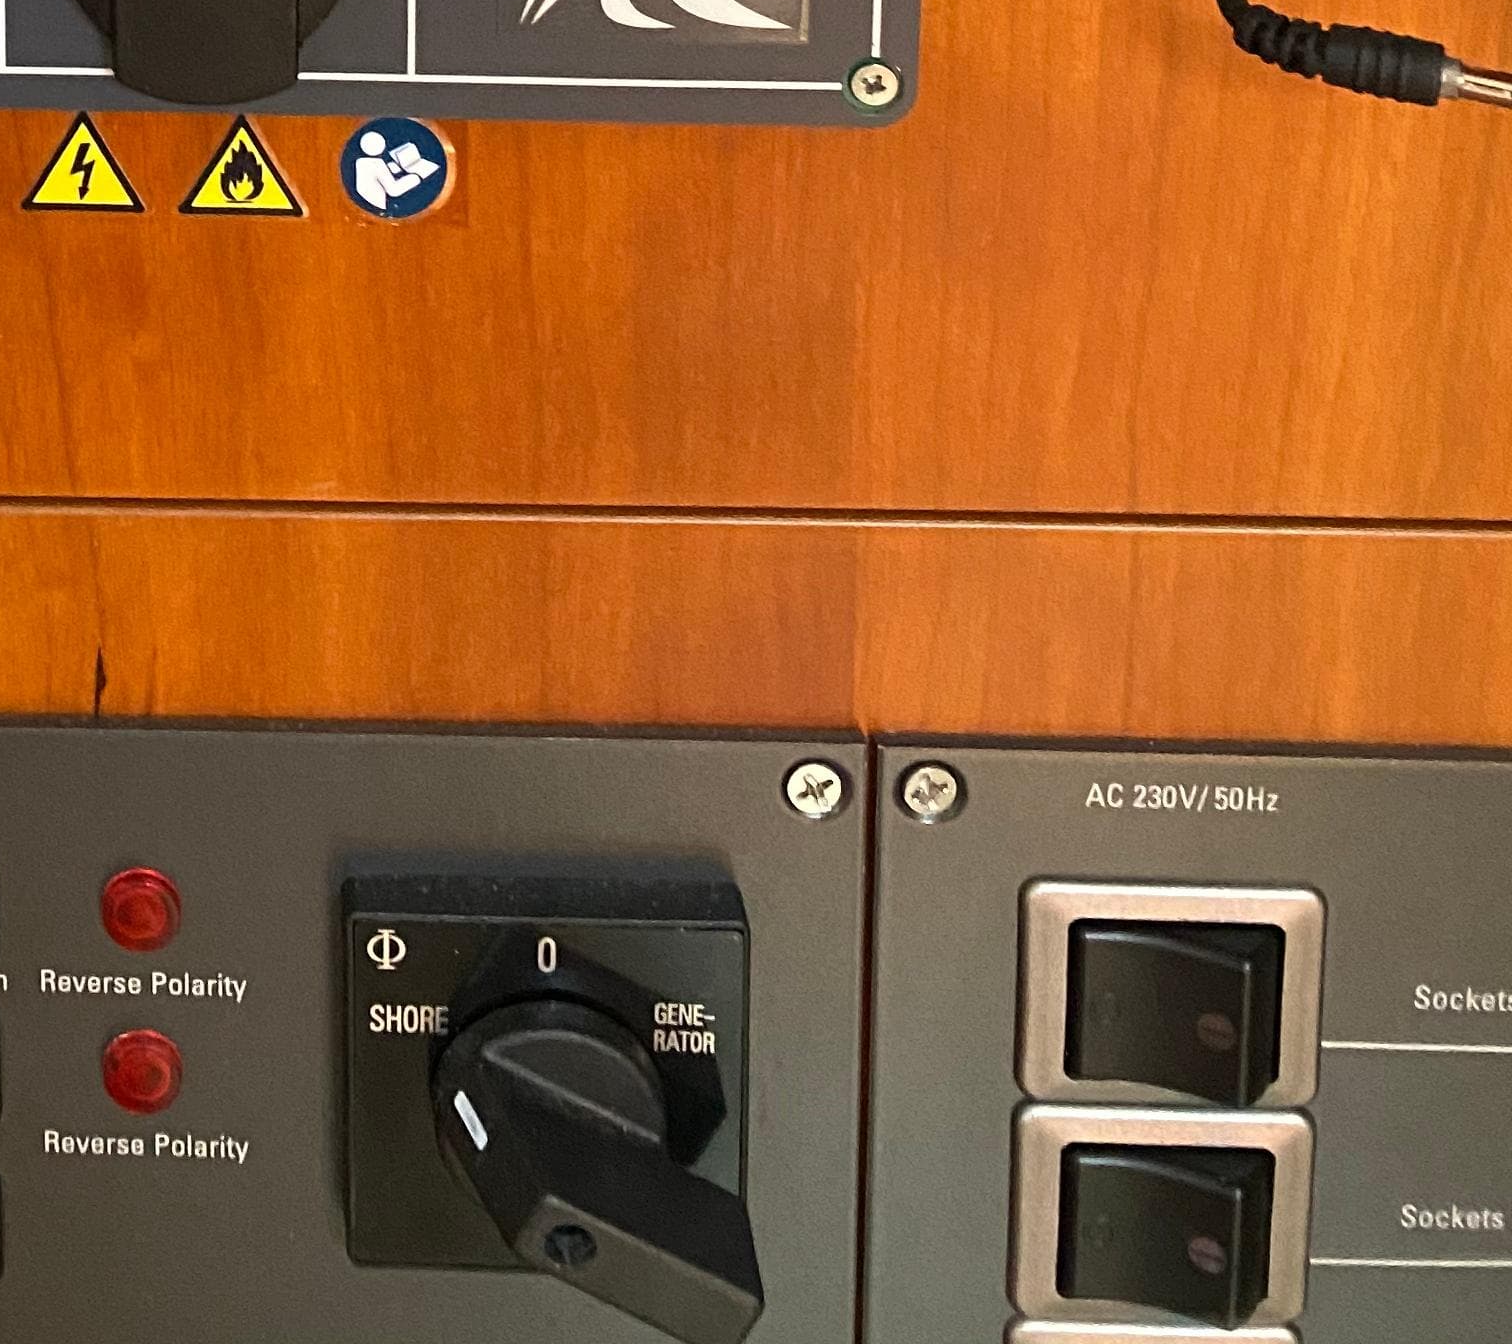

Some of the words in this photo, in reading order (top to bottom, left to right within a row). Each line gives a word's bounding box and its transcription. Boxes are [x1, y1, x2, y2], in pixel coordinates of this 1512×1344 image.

[1085, 782, 1124, 809] AC
[537, 936, 557, 973] 0
[40, 968, 142, 995] Reverse
[151, 971, 247, 1004] Polarity
[369, 1004, 448, 1034] SHORE
[654, 1002, 716, 1027] GENE-
[653, 1029, 716, 1054] RATOR
[44, 1129, 145, 1156] Reverse
[154, 1133, 249, 1165] Polarity
[1400, 1203, 1504, 1229] Sockets
